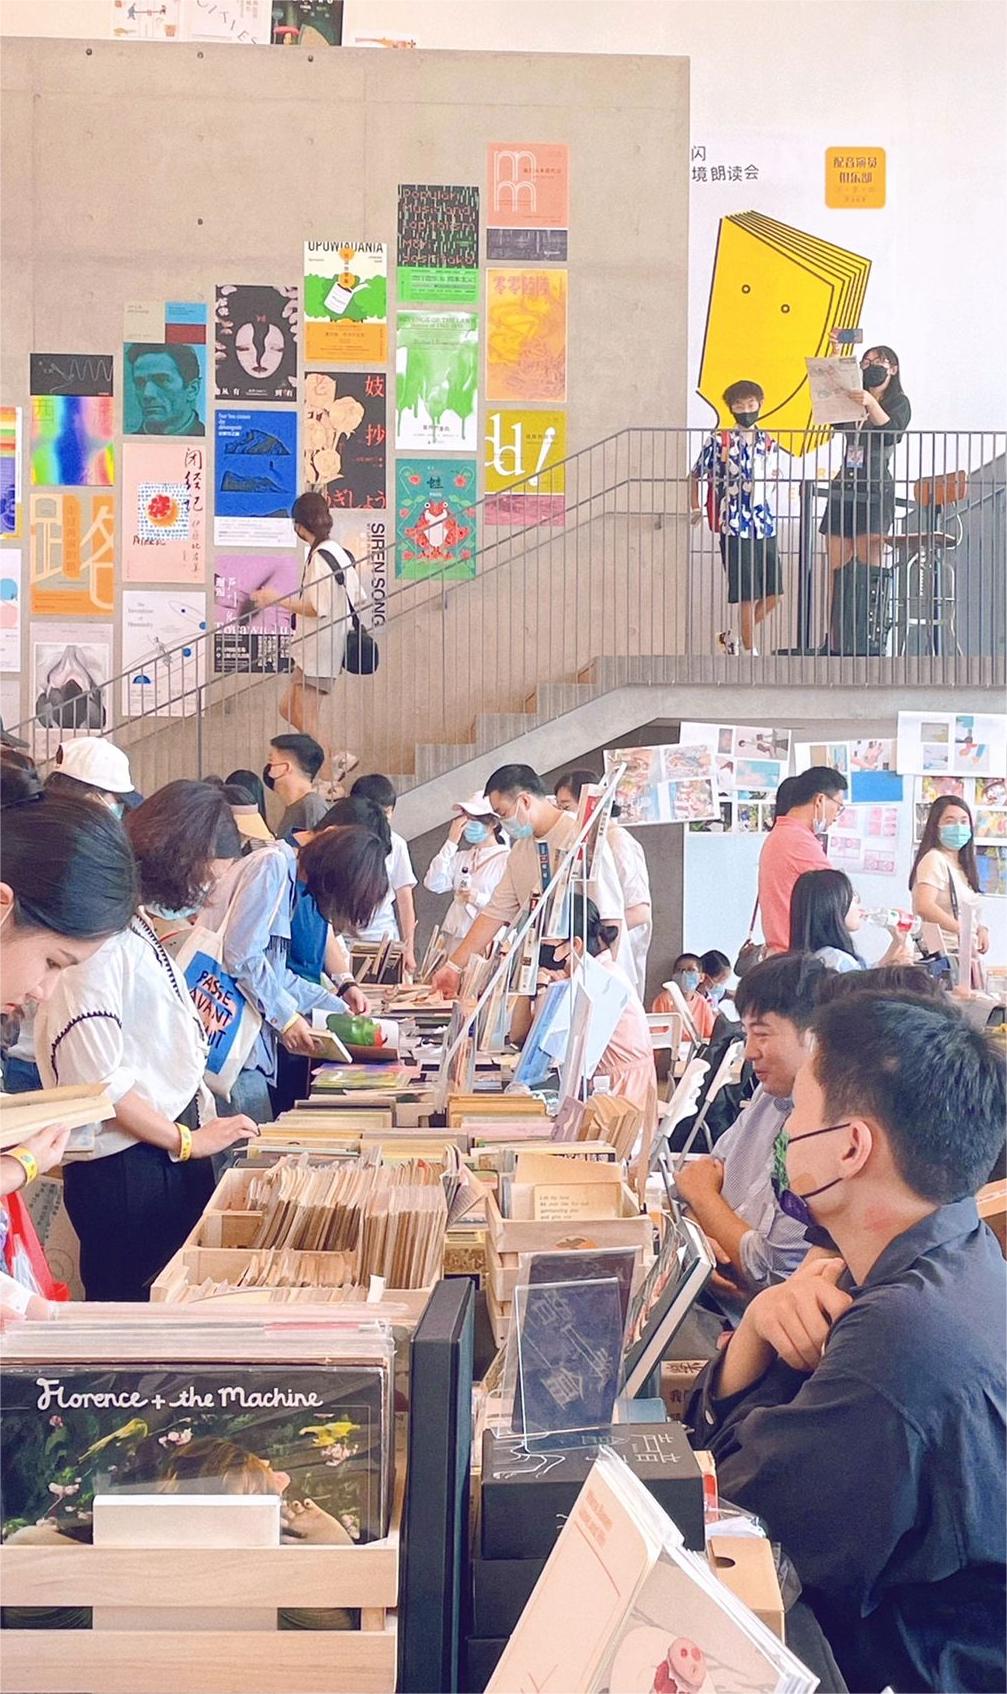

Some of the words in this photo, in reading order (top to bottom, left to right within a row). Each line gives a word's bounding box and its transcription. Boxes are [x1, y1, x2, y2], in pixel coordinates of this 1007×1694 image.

[691, 164, 760, 182] 境朗读会
[371, 523, 385, 574] SIREN
[371, 578, 386, 627] SONG
[196, 970, 235, 1006] PASSE
[36, 1377, 149, 1411] Florence
[169, 1388, 215, 1408] the
[218, 1386, 324, 1408] Machine
